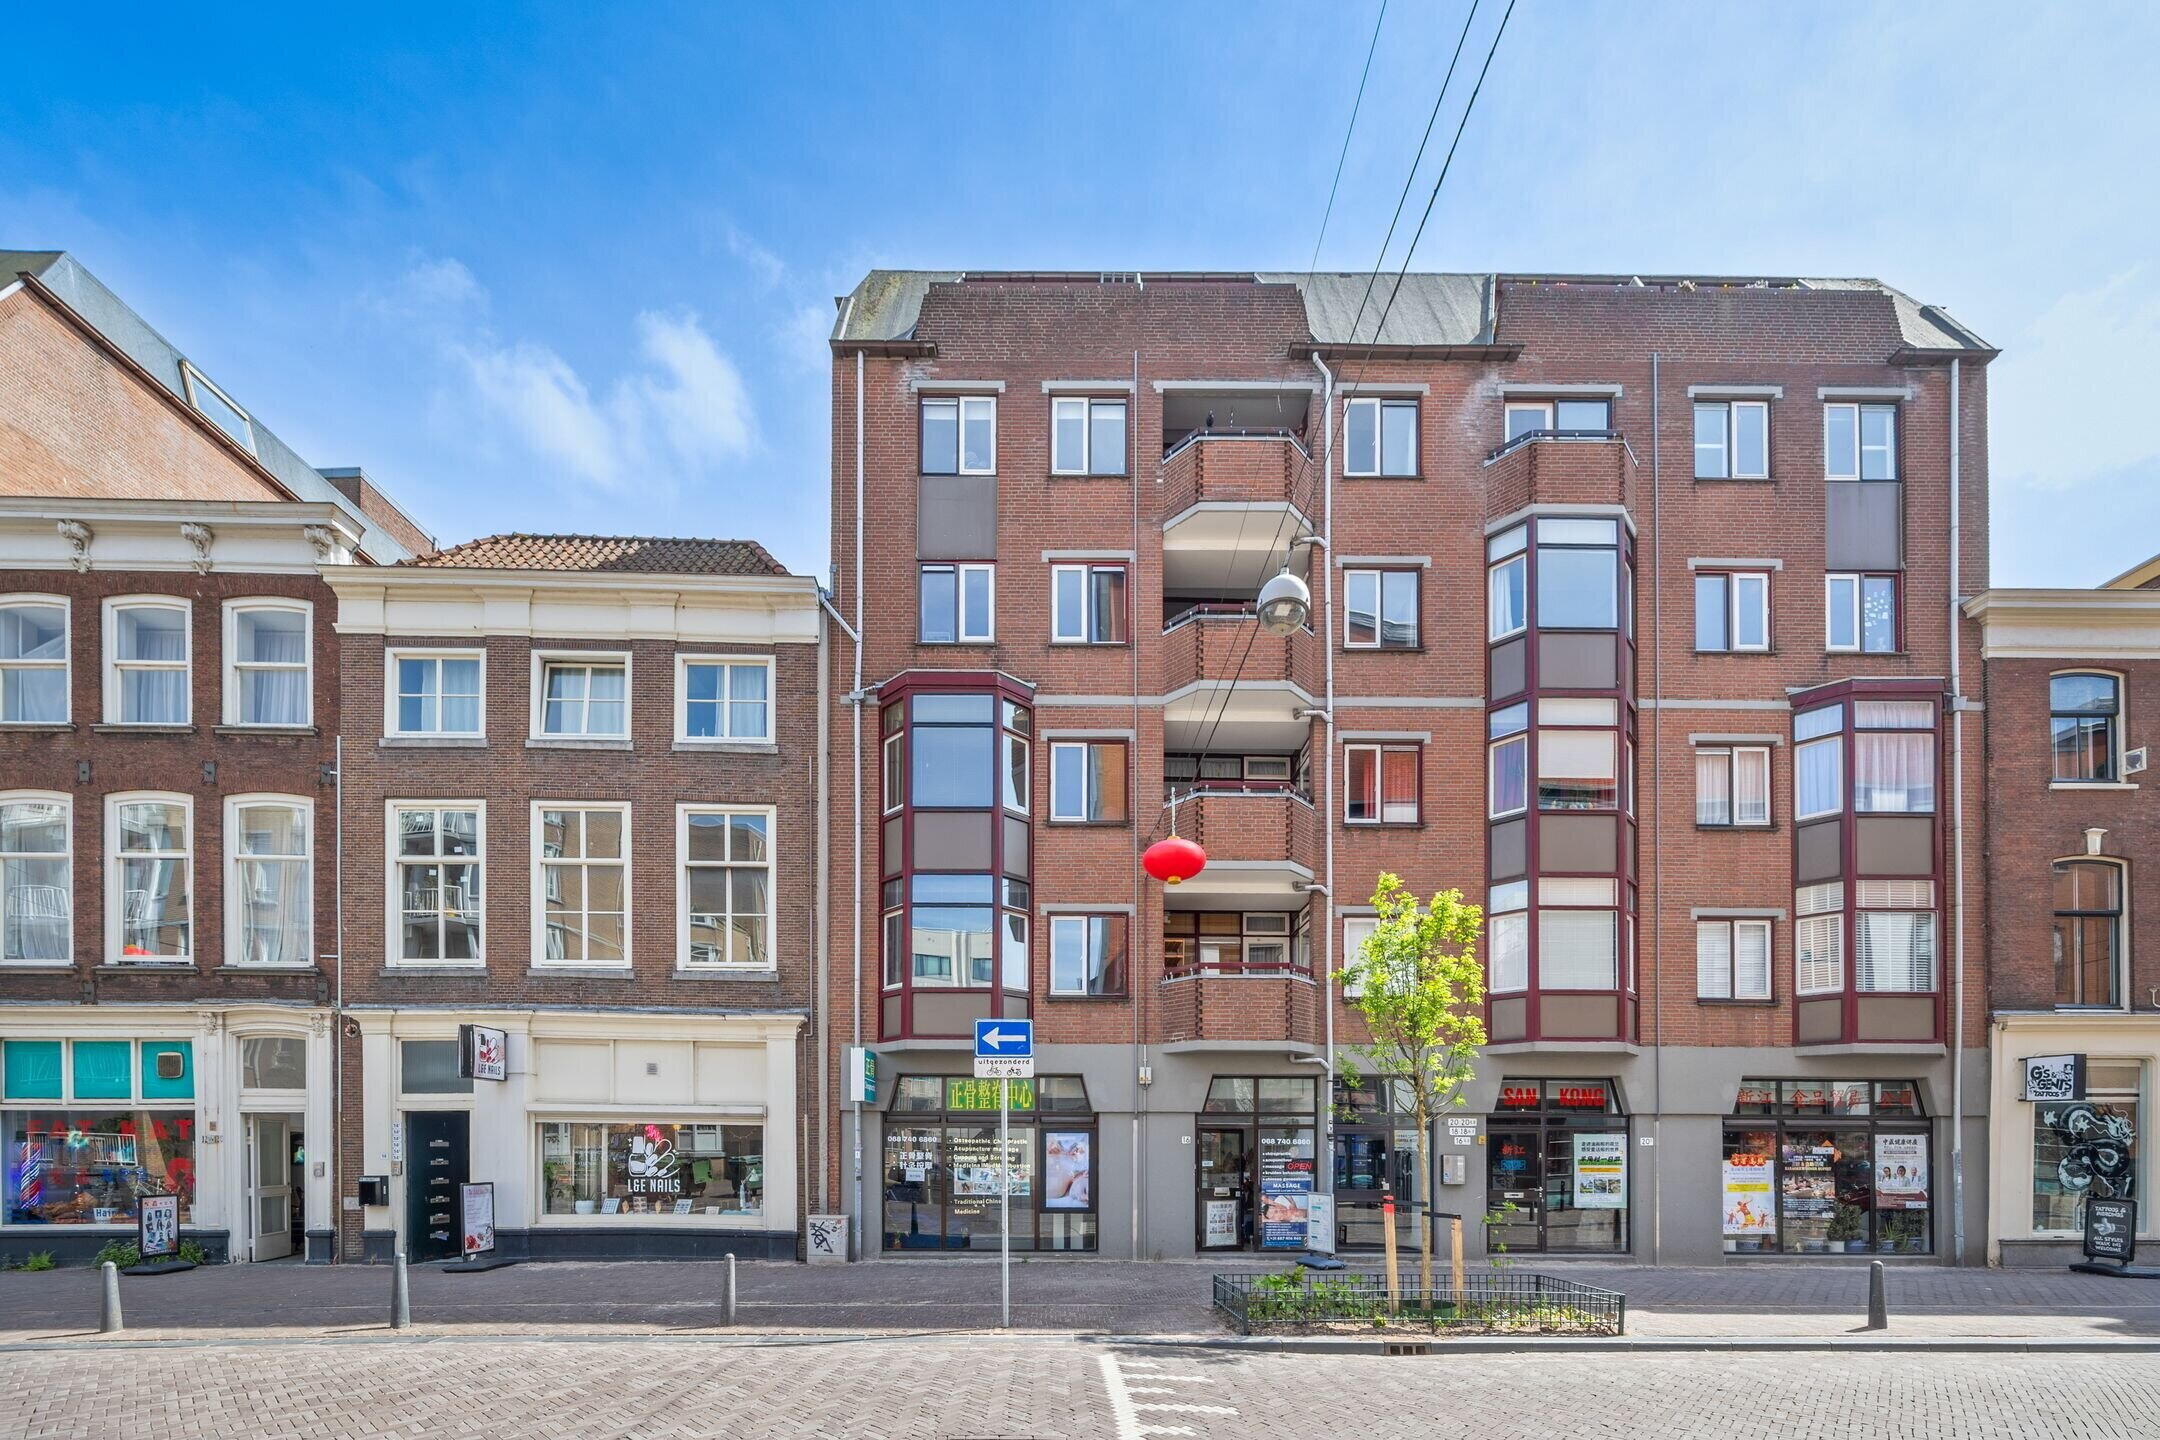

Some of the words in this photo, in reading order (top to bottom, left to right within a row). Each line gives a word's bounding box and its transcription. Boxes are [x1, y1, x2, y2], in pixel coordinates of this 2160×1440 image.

[1504, 1087, 1537, 1106] SAN
[1559, 1088, 1605, 1106] KONG
[1287, 1162, 1312, 1170] OPEN
[627, 1179, 646, 1192] L&E
[650, 1179, 681, 1193] NAILS
